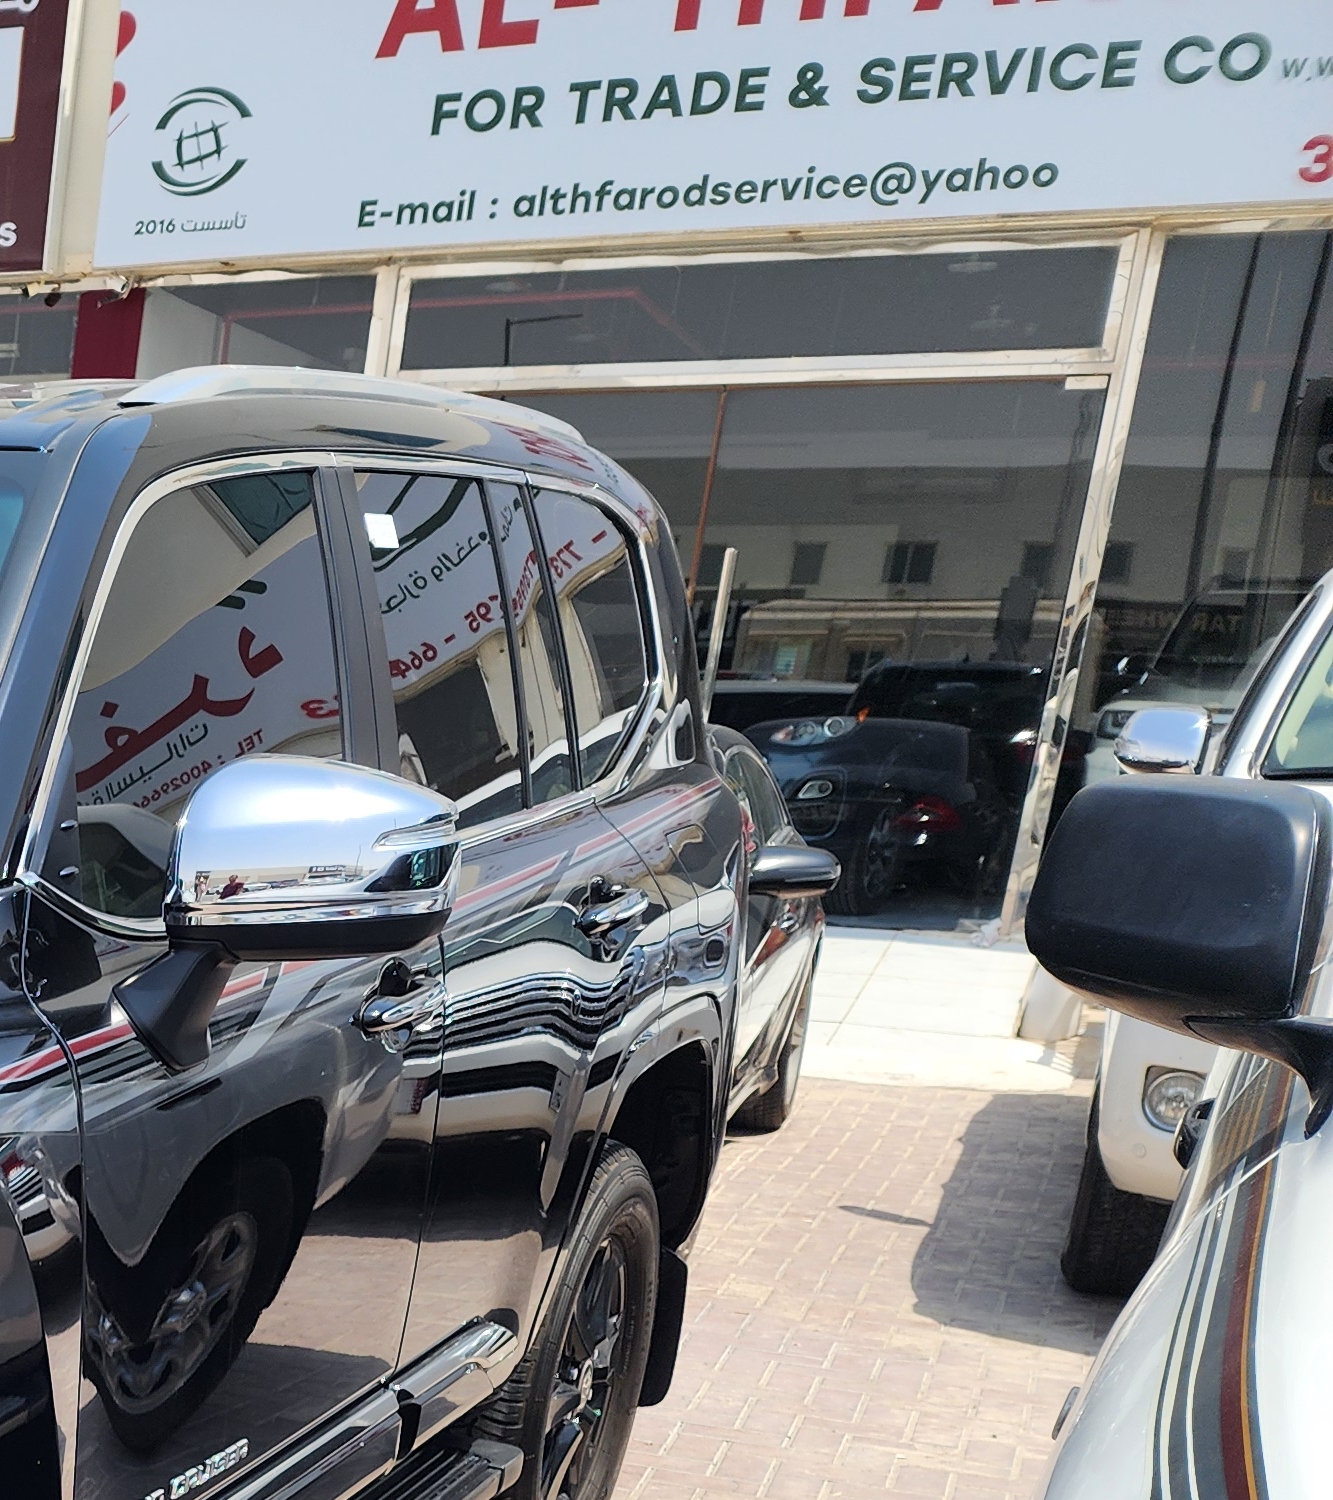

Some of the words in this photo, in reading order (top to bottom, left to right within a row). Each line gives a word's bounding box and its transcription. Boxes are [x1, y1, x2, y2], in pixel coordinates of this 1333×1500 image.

[430, 86, 545, 137] FOR
[569, 66, 770, 126] TRADE
[788, 61, 829, 108] &
[856, 39, 1142, 104] SERVICE
[1163, 31, 1272, 85] CO
[134, 217, 176, 236] 2016
[357, 189, 475, 229] E-mail
[488, 197, 499, 220] :
[512, 156, 1059, 219] althfarodservice@yahoo
